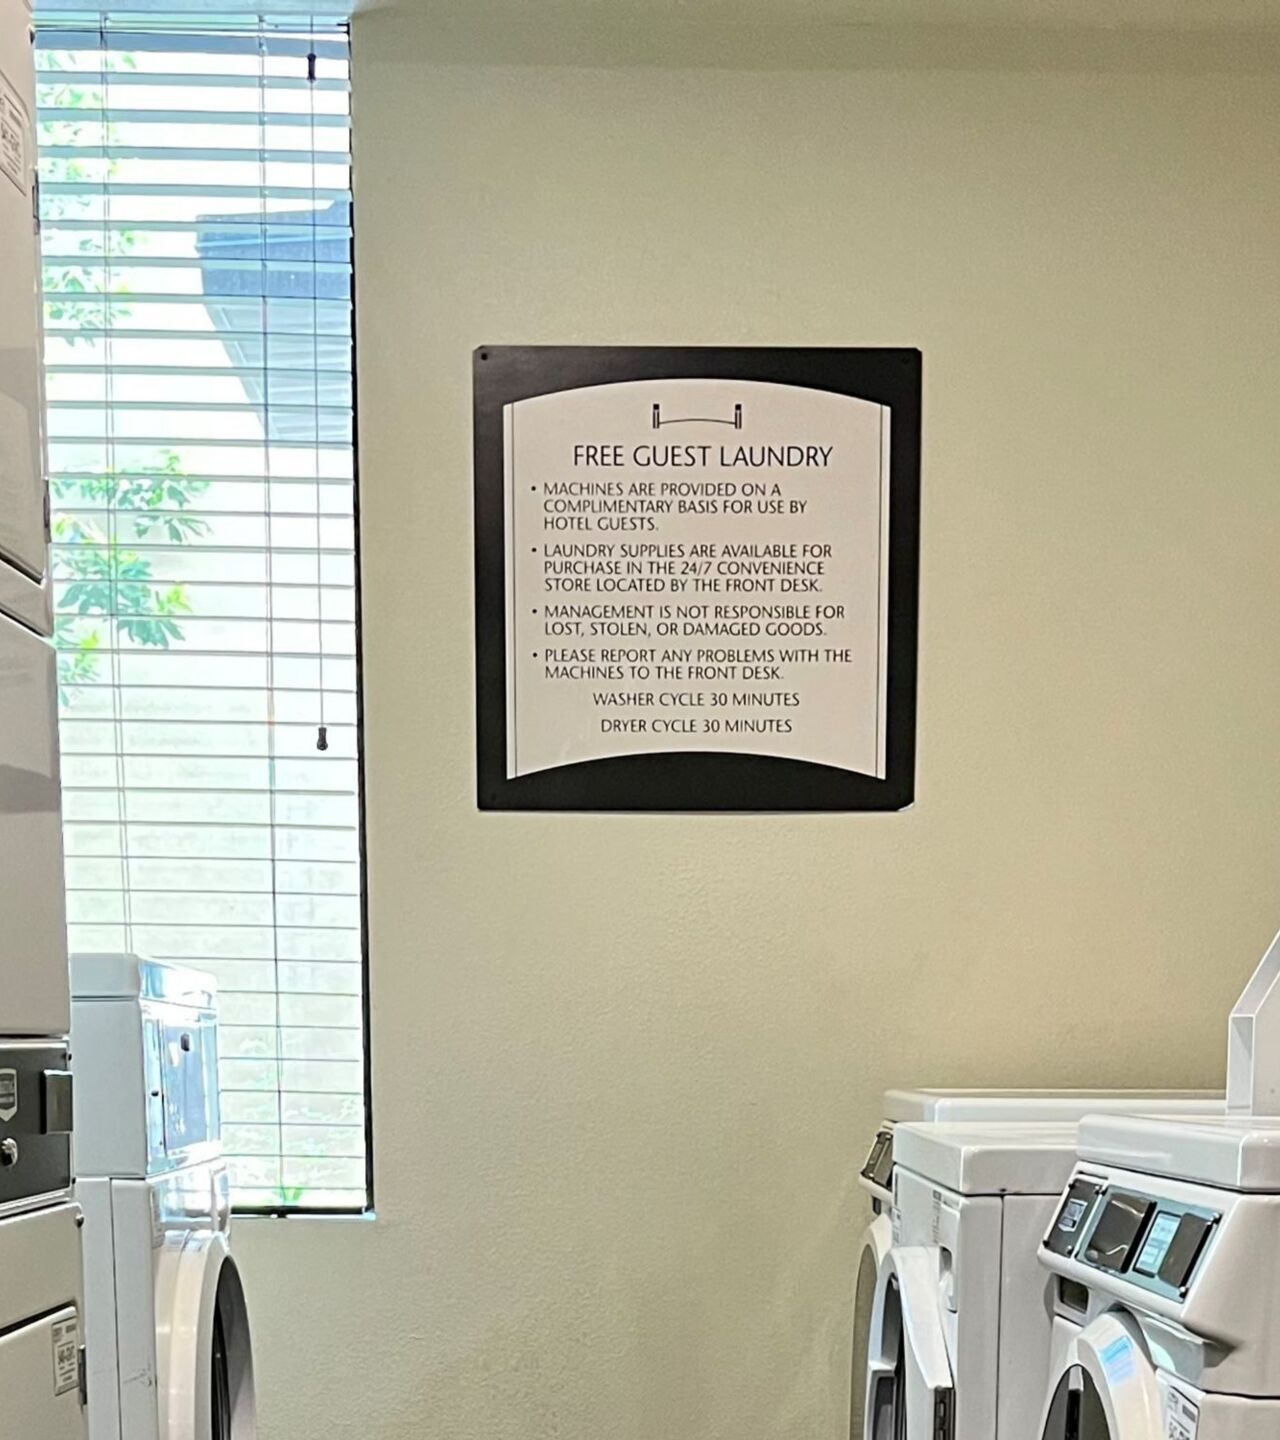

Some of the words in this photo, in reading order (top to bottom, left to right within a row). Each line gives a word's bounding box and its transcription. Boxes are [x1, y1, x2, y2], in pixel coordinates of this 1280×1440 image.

[572, 445, 626, 467] FREE
[631, 445, 713, 467] GUEST
[719, 445, 834, 467] LAUNDRY
[543, 482, 625, 497] MACHINES
[627, 482, 657, 497] ARE
[660, 482, 737, 497] PROVIDED
[741, 482, 768, 497] ON
[770, 482, 782, 497] A
[543, 500, 674, 514] COMPLIMENTARY
[677, 500, 719, 514] BASIS
[722, 500, 753, 514] FOR
[757, 500, 785, 514] USE
[789, 500, 809, 514] BY
[543, 517, 593, 531] HOTEL
[597, 517, 660, 531] GUESTS.
[543, 544, 616, 558] LAUNDRY
[620, 544, 686, 558] SUPPLIES
[689, 544, 718, 558] ARE
[720, 544, 798, 558] AVAILABLE
[801, 544, 833, 558] FOR
[543, 561, 623, 575] PURCHASE
[626, 561, 643, 575] IN
[646, 561, 676, 575] THE
[680, 561, 713, 575] 24/7
[716, 561, 826, 575] CONVENIENCE
[544, 578, 592, 592] STORE
[596, 578, 666, 592] LOCATED
[670, 578, 689, 592] BY
[692, 578, 721, 592] THE
[725, 578, 777, 592] FRONT
[780, 578, 823, 592] DESK.
[544, 605, 655, 619] MANAGEMENT
[659, 605, 672, 619] IS
[676, 605, 709, 619] NOT
[713, 605, 811, 619] RESPONSIBLE
[815, 605, 846, 619] FOR
[544, 622, 585, 639] LOST,
[589, 622, 652, 639] STOLEN,
[656, 622, 679, 637] OR
[682, 622, 761, 637] DAMAGED
[764, 622, 828, 637] GOODS.
[544, 648, 596, 663] PLEASE
[600, 648, 656, 663] REPORT
[660, 648, 693, 663] ANY
[696, 648, 775, 663] PROBLEMS
[778, 648, 820, 663] WITH
[823, 648, 853, 663] THE
[544, 666, 625, 680] MACHINES
[628, 666, 651, 680] TO
[654, 666, 684, 680] THE
[687, 666, 738, 680] FRONT
[742, 666, 786, 680] DESK.
[592, 692, 655, 707] WASHER
[658, 692, 706, 707] CYCLE
[709, 692, 729, 707] 30
[731, 692, 801, 707] MINUTES
[600, 719, 648, 733] DRYER
[651, 719, 699, 733] CYCLE
[702, 719, 721, 733] 30
[724, 719, 793, 733] MINUTES
